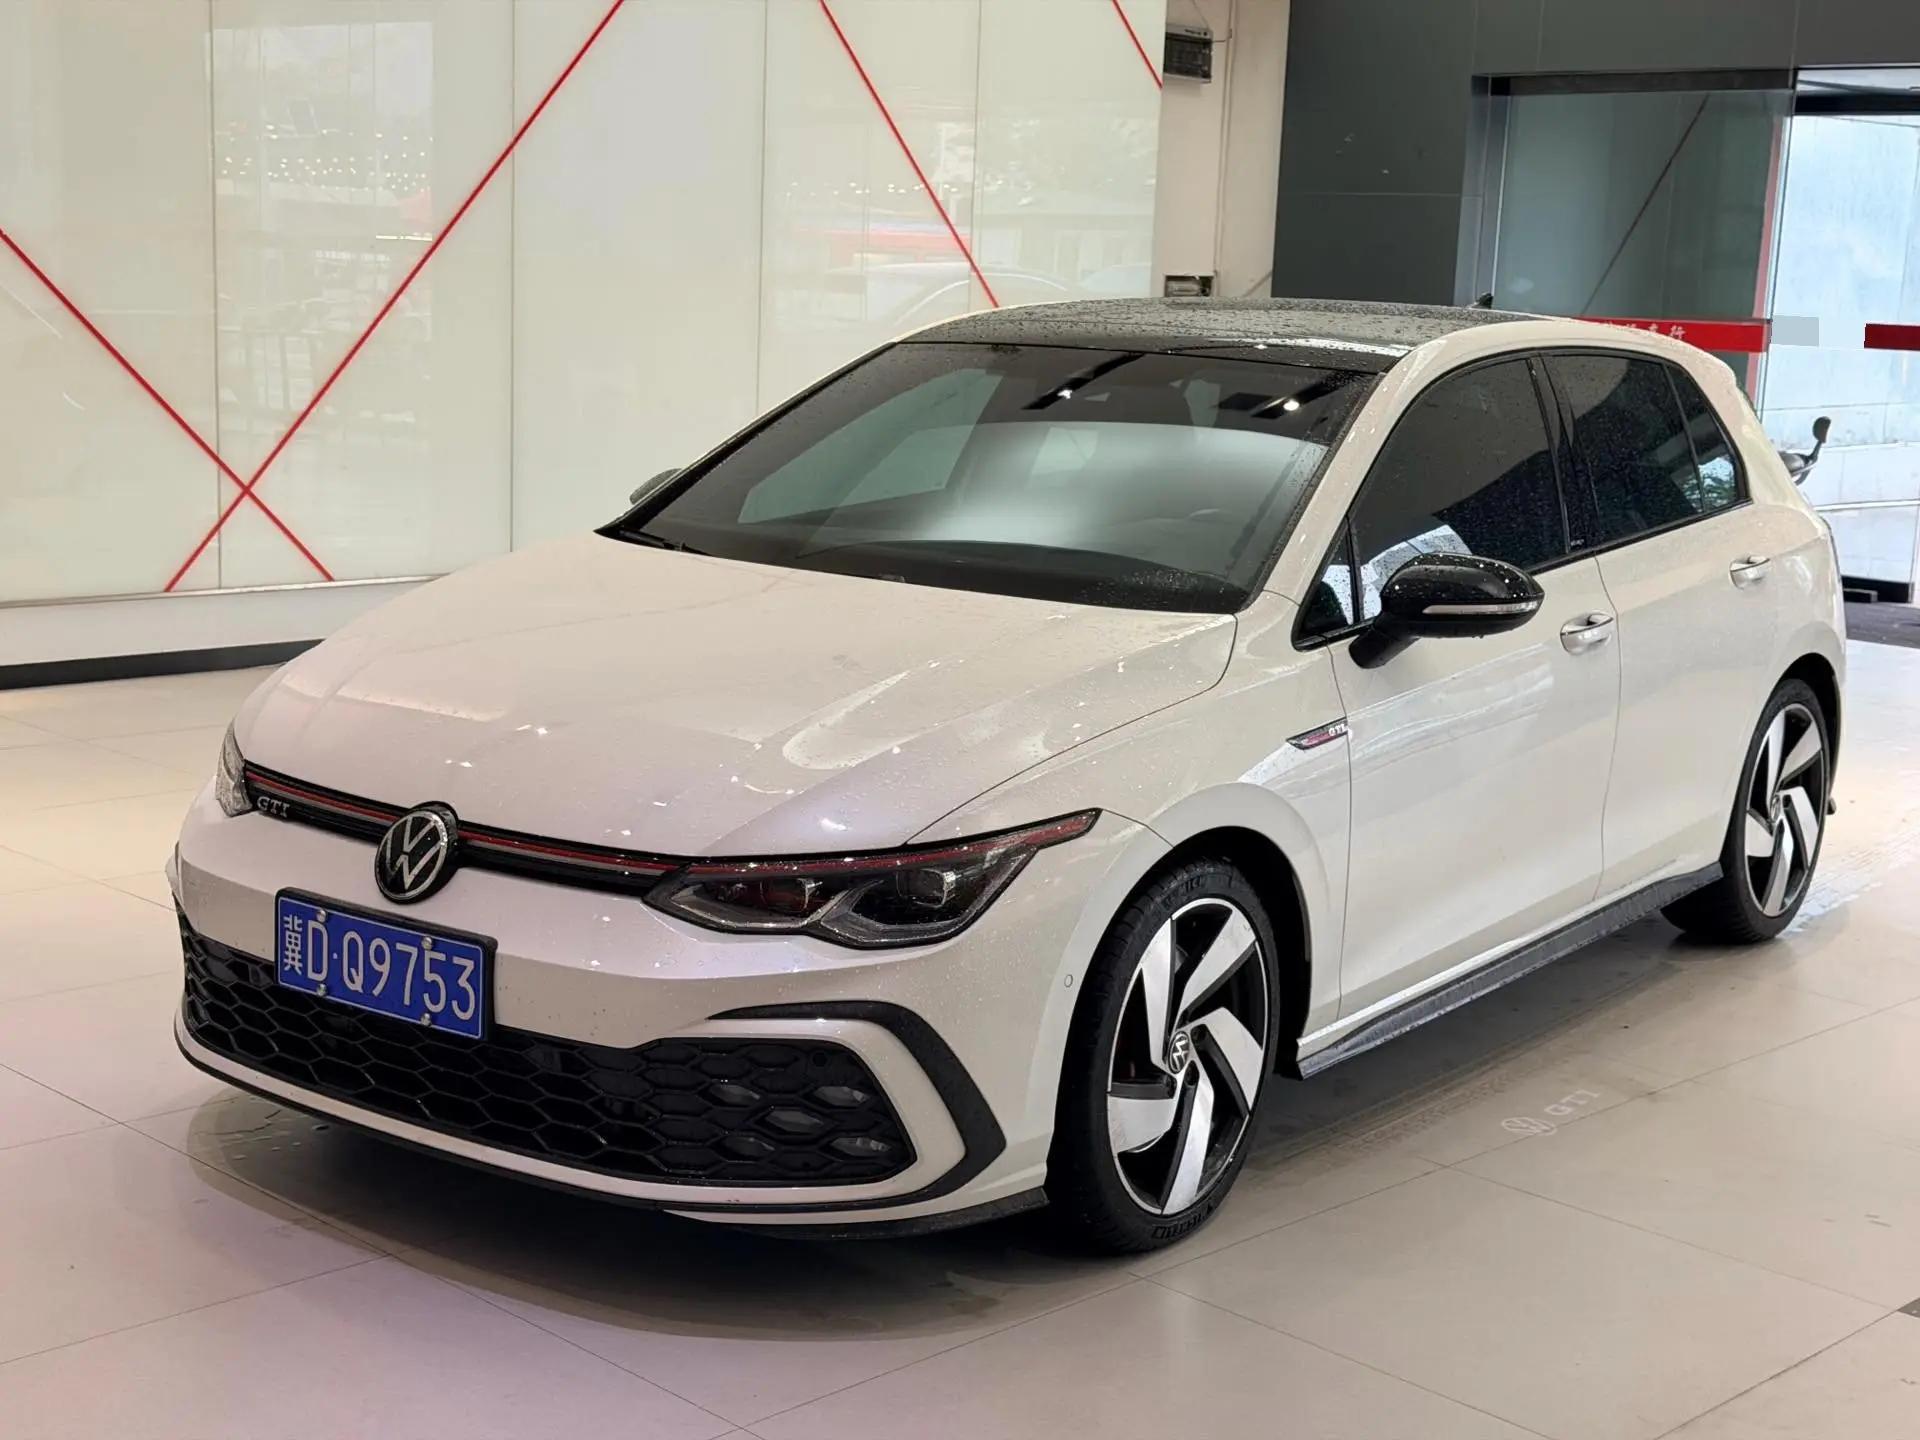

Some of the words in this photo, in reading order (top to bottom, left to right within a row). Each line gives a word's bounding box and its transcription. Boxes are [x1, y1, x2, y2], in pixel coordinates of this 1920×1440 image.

[1328, 723, 1346, 737] GTI
[257, 796, 291, 818] GTI
[1544, 1089, 1600, 1116] GTI
